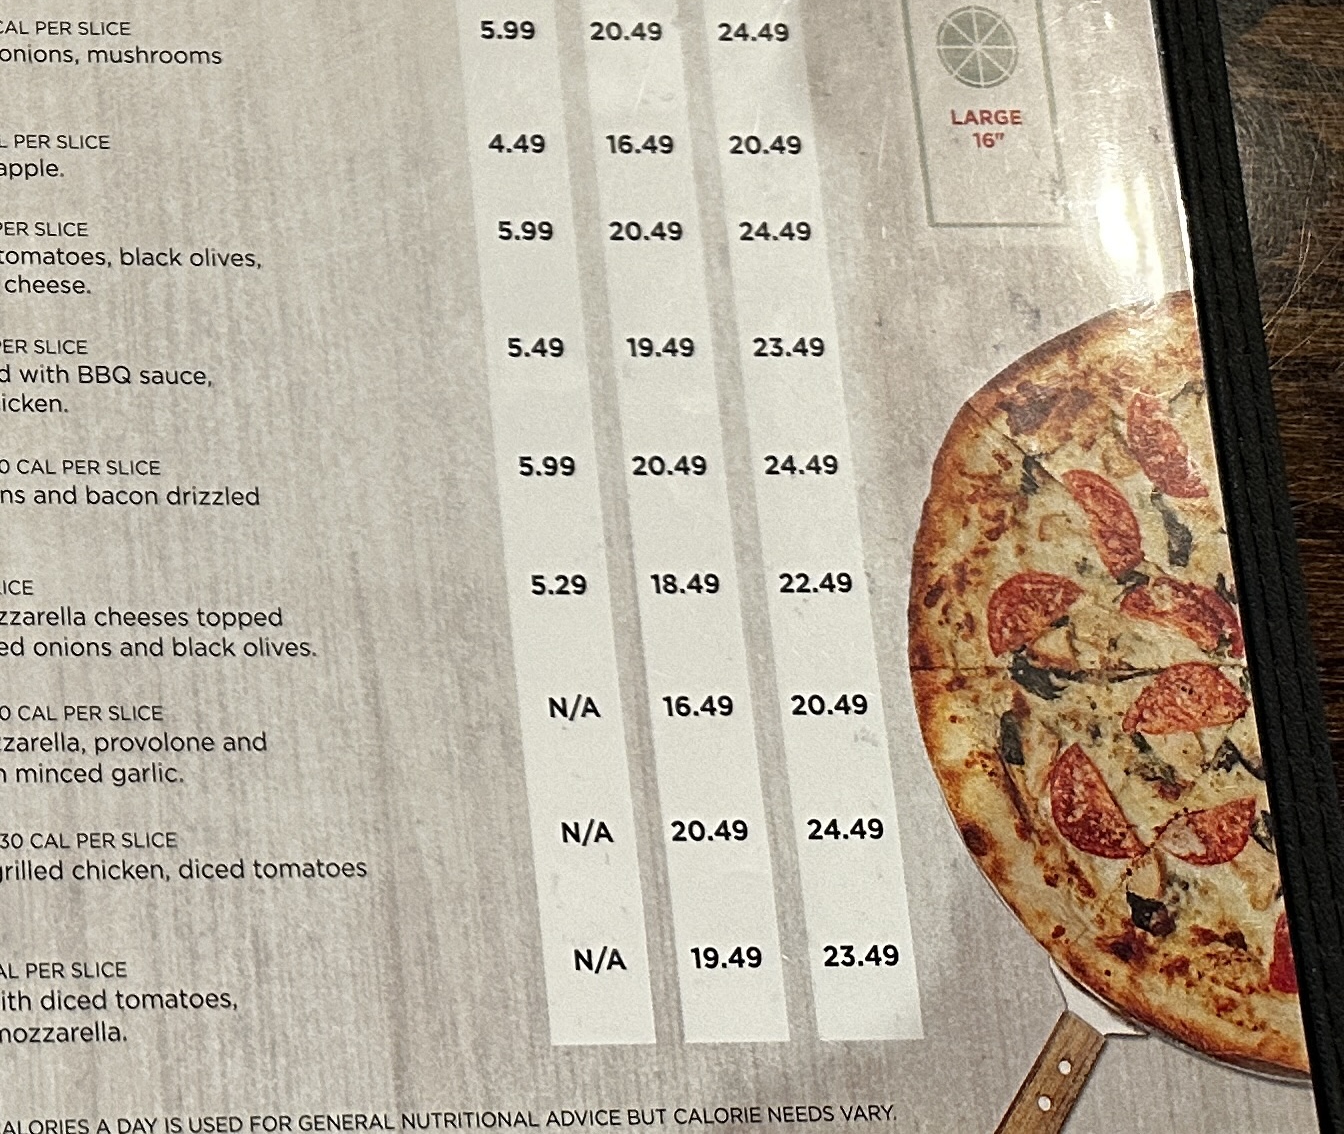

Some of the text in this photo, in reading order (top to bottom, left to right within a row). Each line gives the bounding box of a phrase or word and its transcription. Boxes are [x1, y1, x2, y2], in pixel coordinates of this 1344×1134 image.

[951, 109, 1022, 126] LARGE
[532, 575, 587, 595] 5.29
[651, 574, 719, 594] 18.49
[779, 573, 852, 593] 22.49
[574, 946, 627, 974] N/A
[691, 947, 762, 969] 19.49
[824, 945, 898, 967] 23.49
[26, 963, 64, 978] PER
[72, 962, 127, 978] SLICE
[97, 1119, 111, 1134] A
[118, 1118, 157, 1134] DAY
[165, 1118, 182, 1133] IS
[189, 1117, 243, 1133] USED
[250, 1116, 292, 1132] FOR
[299, 1114, 395, 1131] GENERAL
[402, 1111, 539, 1129] NUTRITIONAL
[546, 1110, 621, 1127] ADVICE
[628, 1109, 666, 1125] BUT
[674, 1107, 762, 1124] CALORIE
[768, 1106, 834, 1122] NEEDS
[840, 1105, 896, 1121] VARY.
